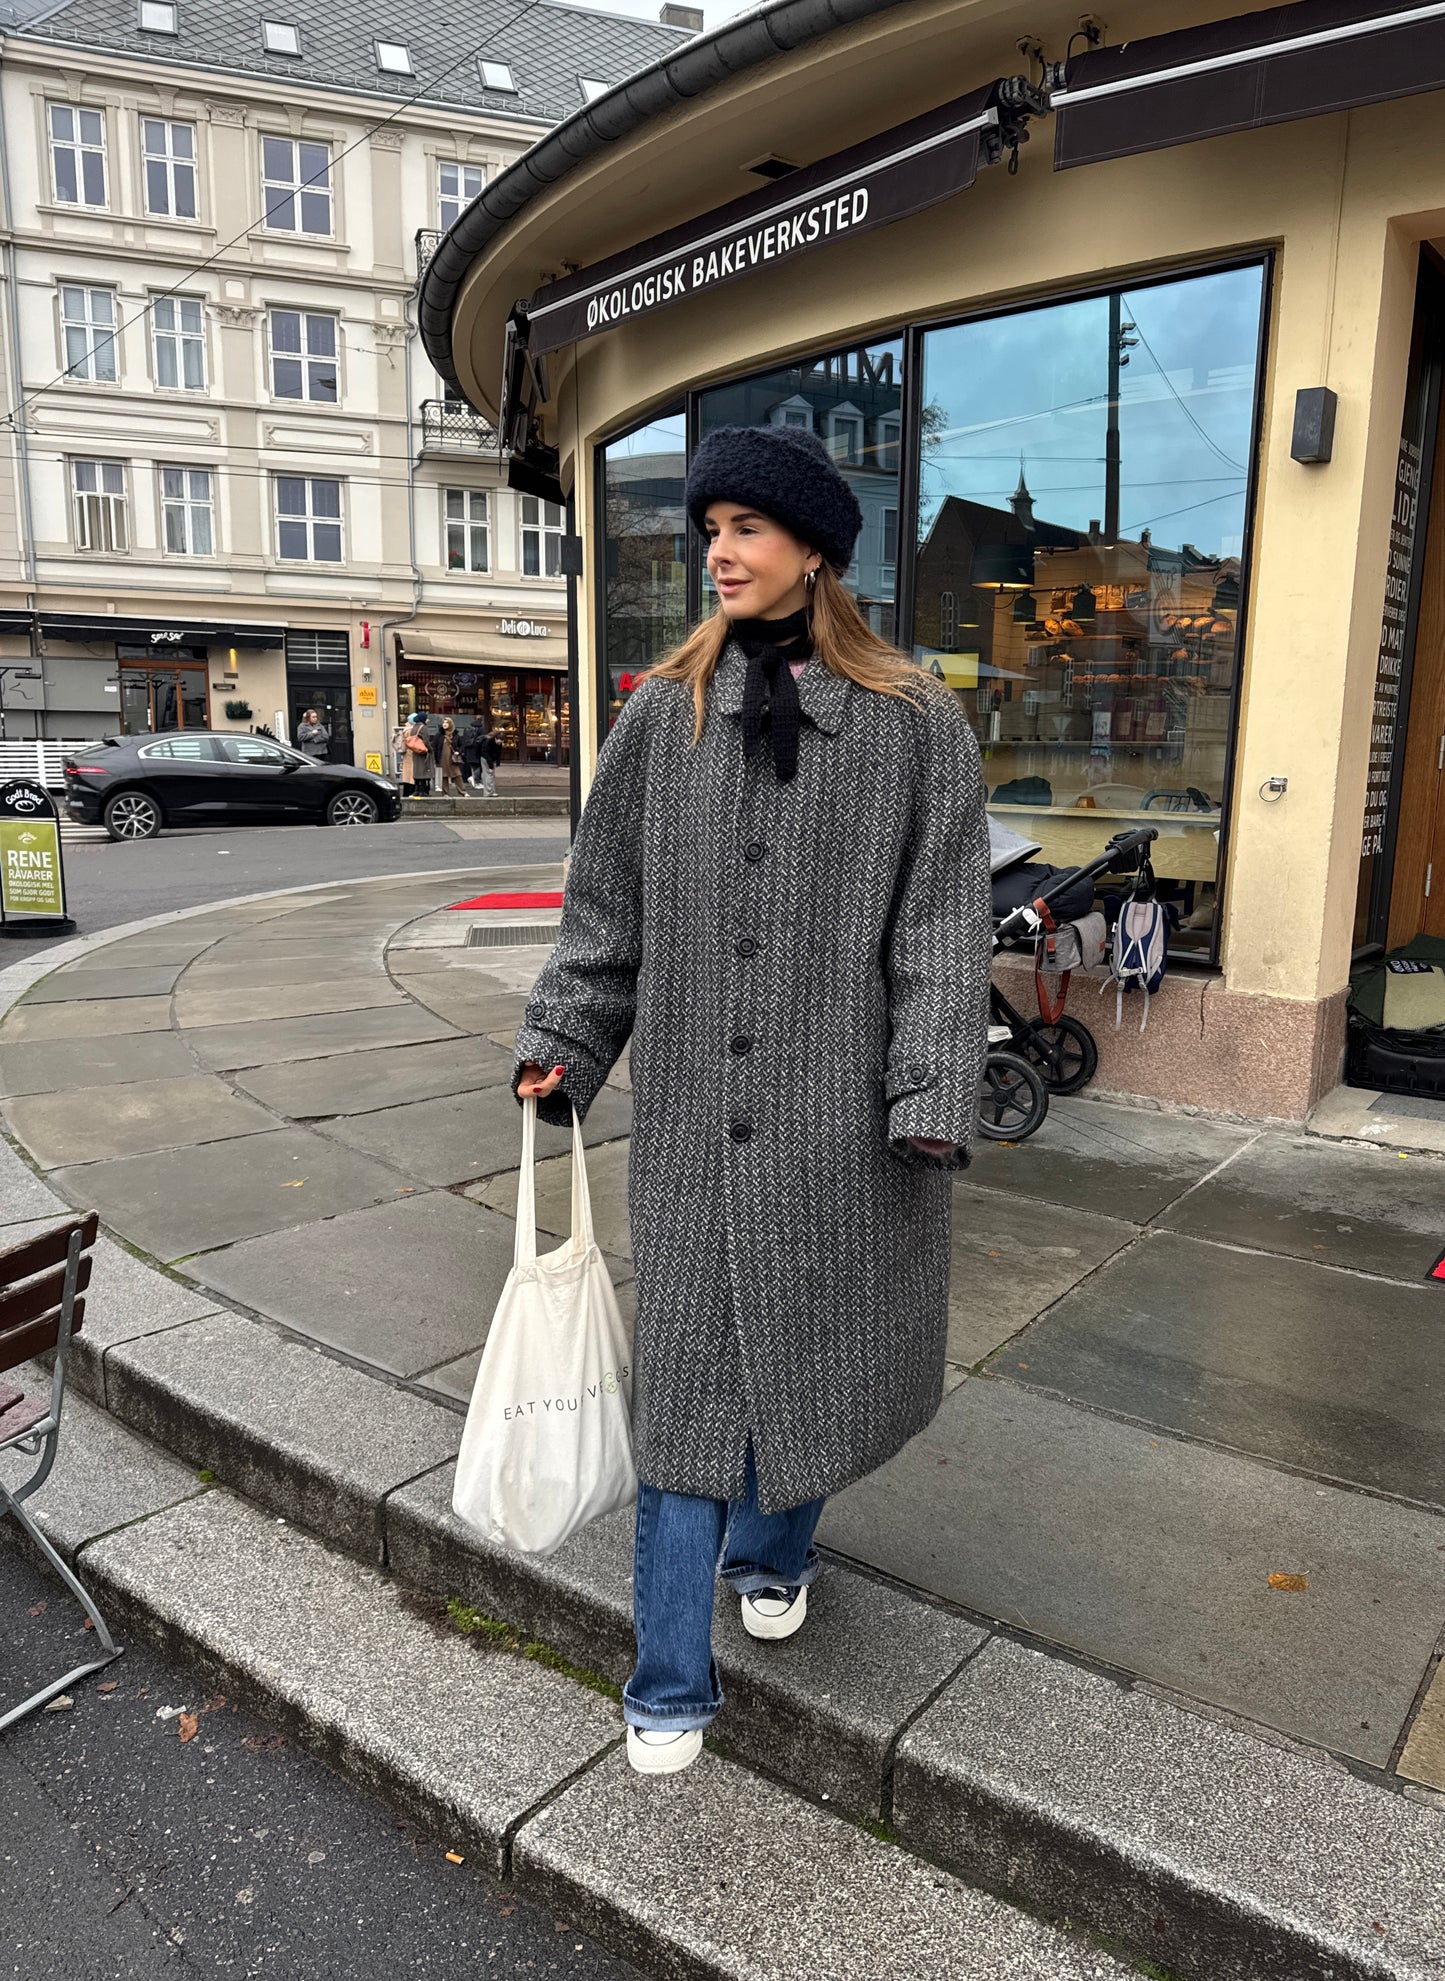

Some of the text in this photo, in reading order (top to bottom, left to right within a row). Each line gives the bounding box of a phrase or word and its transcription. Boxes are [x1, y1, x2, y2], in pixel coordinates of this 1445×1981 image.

[586, 188, 869, 331] ØKOLOGISK BAKEVERKSTED
[502, 619, 517, 635] Deli
[531, 621, 547, 636] Luca
[1388, 627, 1405, 650] MAT
[1380, 655, 1401, 677] DRIKKE
[5, 788, 44, 805] Godt Brød
[8, 850, 53, 868] RENE
[8, 866, 53, 881] RÅVARER
[504, 1402, 535, 1420] EAT
[543, 1395, 584, 1411] YOU
